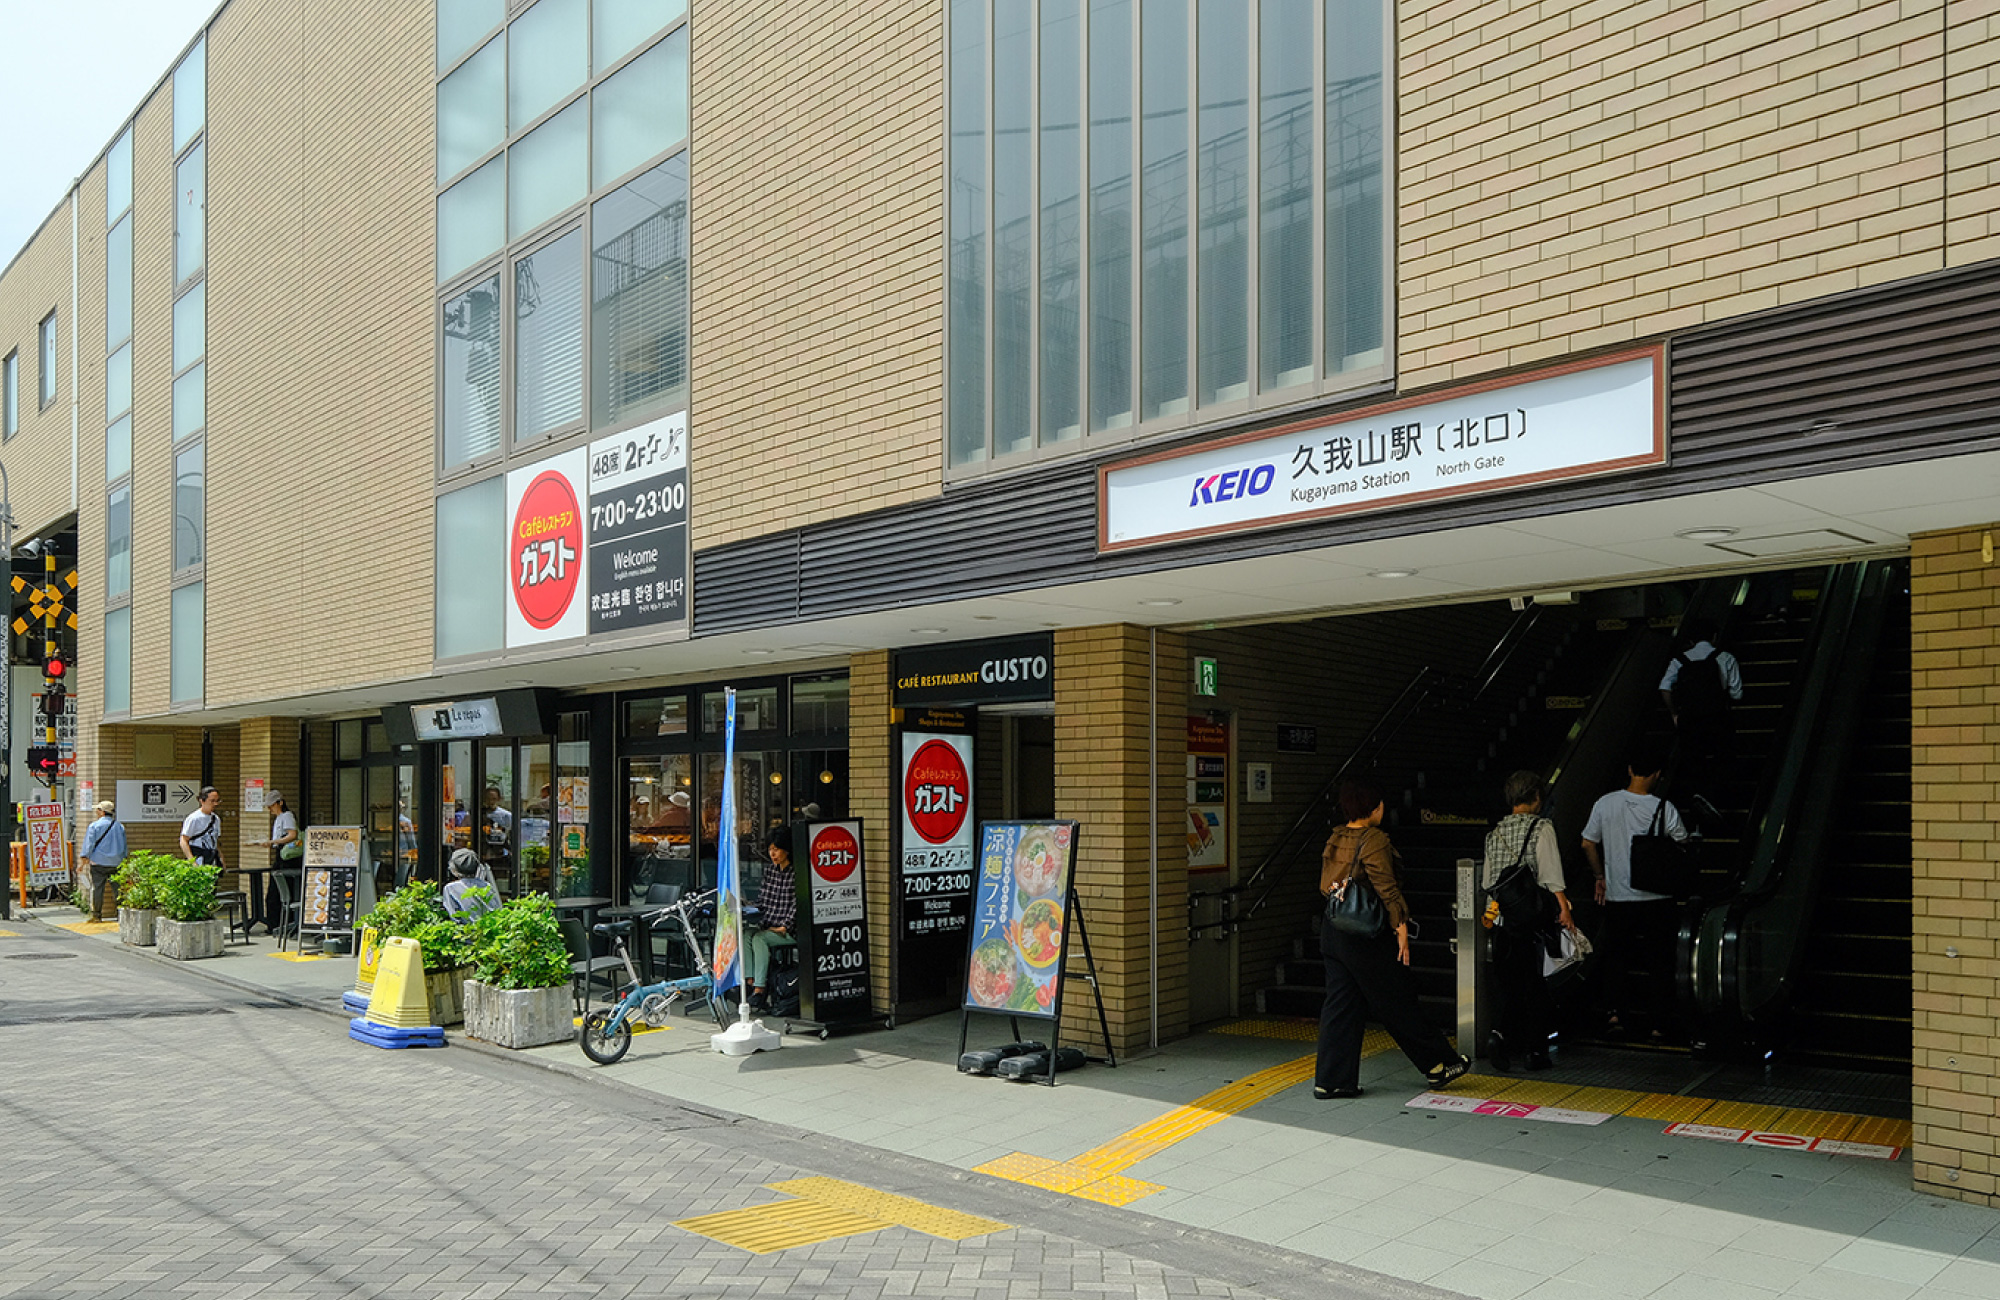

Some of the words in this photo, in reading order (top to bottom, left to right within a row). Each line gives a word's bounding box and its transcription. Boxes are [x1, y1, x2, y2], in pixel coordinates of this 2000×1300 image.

[592, 451, 619, 477] 48席
[624, 441, 646, 472] 2F
[1291, 422, 1422, 479] 久我山駅
[1189, 464, 1276, 508] KEIO
[1290, 481, 1358, 503] Kugayama
[1361, 469, 1410, 491] Station
[1436, 460, 1471, 477] North
[1473, 455, 1505, 470] Gate
[519, 511, 573, 539] Caféレストラン
[519, 536, 576, 589] ガスト
[613, 548, 659, 570] Welcome
[635, 583, 653, 604] 환영
[656, 577, 684, 600] 합니다
[898, 674, 919, 689] CAFÉ
[921, 671, 979, 688] RESTAURANT
[981, 655, 1048, 684] GUSTO
[451, 708, 462, 721] Le
[913, 766, 961, 780] Caféレストラン
[914, 783, 964, 814] ガスト
[309, 841, 325, 851] SET
[310, 831, 349, 841] MORNING
[817, 849, 855, 868] ガスト
[823, 925, 862, 945] 7:00
[817, 951, 863, 973] 23:00
